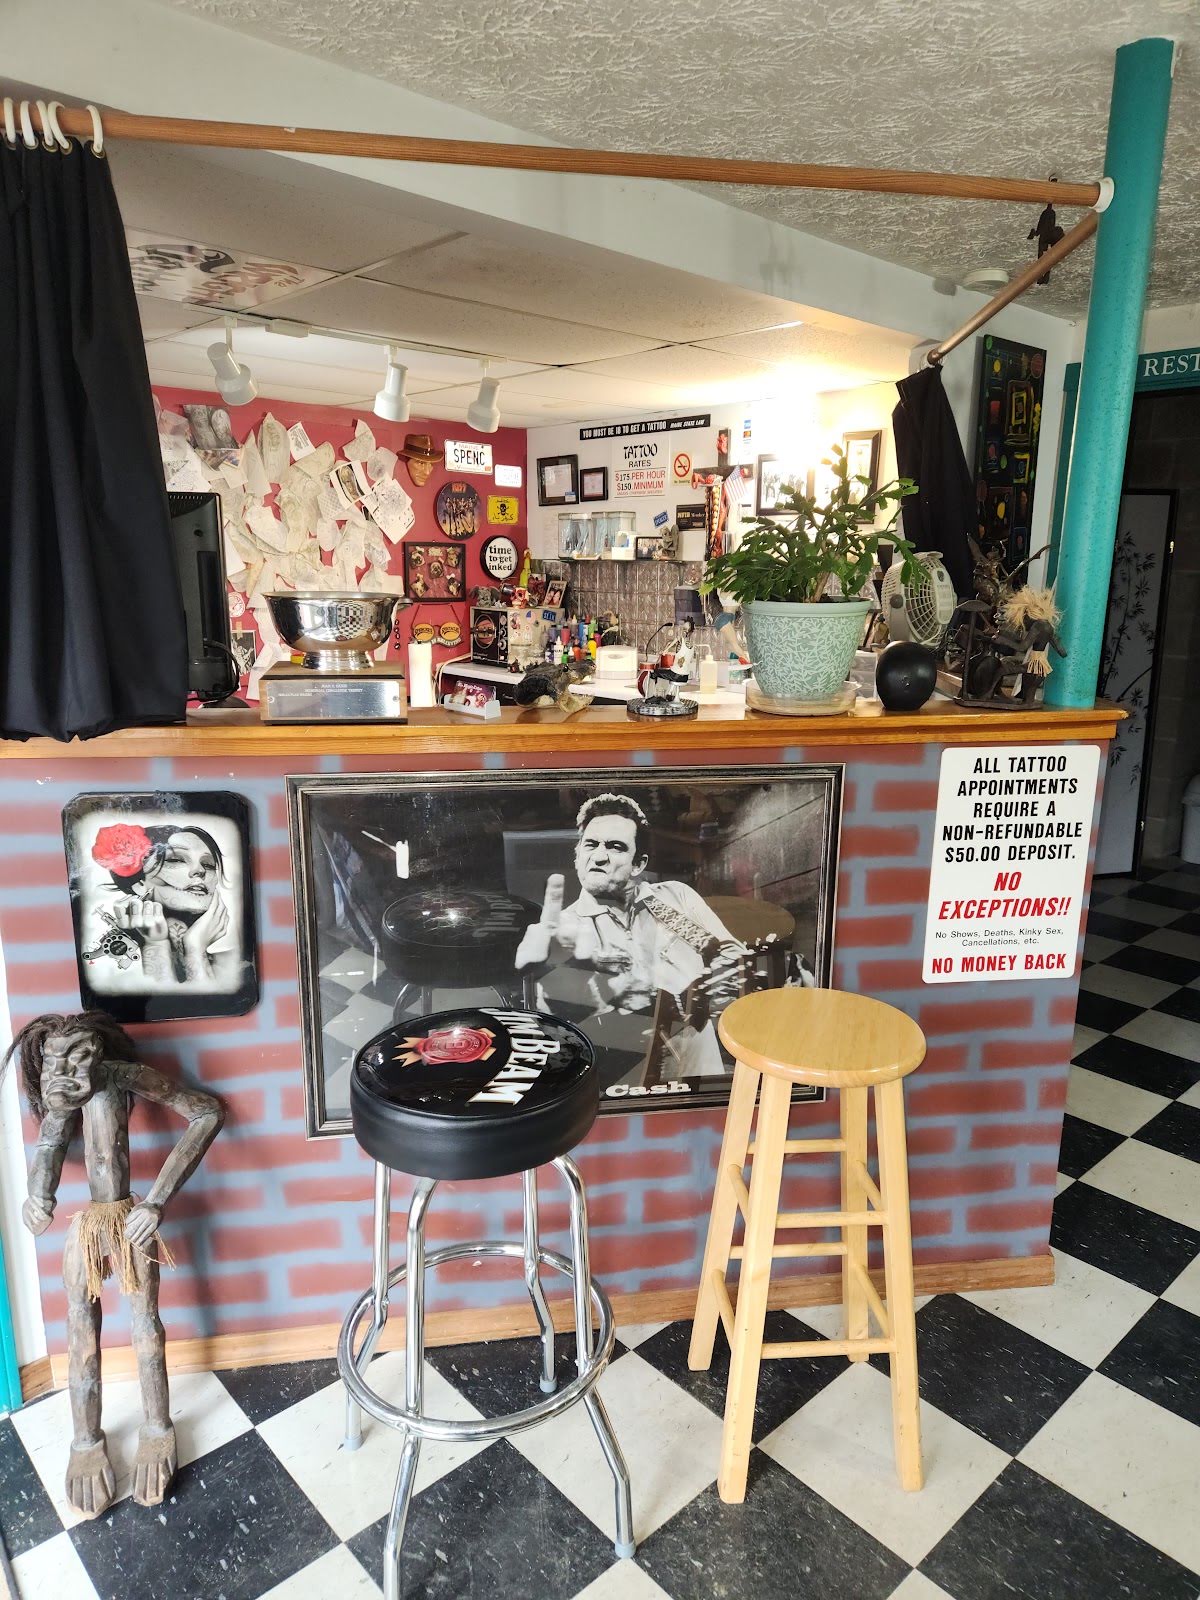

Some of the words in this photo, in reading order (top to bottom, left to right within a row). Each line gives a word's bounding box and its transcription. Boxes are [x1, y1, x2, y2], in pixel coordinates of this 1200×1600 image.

[583, 430, 592, 439] YOU
[593, 428, 607, 437] MUST
[622, 425, 630, 434] TO
[630, 424, 641, 433] GET
[641, 423, 646, 432] A
[646, 421, 667, 431] TATTOO
[453, 448, 485, 465] SPENC
[623, 443, 658, 459] TATTOO
[628, 459, 652, 468] RATES
[631, 472, 644, 480] PER
[646, 470, 665, 479] HOUR
[633, 480, 664, 490] MINIMUM
[489, 545, 512, 555] time
[488, 563, 512, 571] inked
[499, 556, 512, 564] get
[973, 757, 1000, 774] ALL
[1008, 755, 1067, 773] TATTOO
[957, 777, 1078, 797] APPOINTMENTS
[973, 801, 1039, 820] REQUIRE
[1046, 800, 1056, 817] A
[942, 822, 1083, 841] NON-REFUNDABLE
[945, 845, 1000, 863] $50.00
[1007, 844, 1076, 861] DEPOSIT.
[993, 871, 1022, 891] NO
[938, 897, 1072, 920] EXCEPTIONS!!
[935, 931, 947, 939] No
[950, 930, 981, 938] Shows,
[984, 928, 1016, 937] Deaths,
[1019, 928, 1042, 936] Kinky
[1045, 927, 1064, 936] Sex,
[962, 938, 1021, 947] Cancellations,
[1023, 937, 1040, 945] etc.
[932, 957, 953, 974] NO
[961, 955, 1017, 973] MONEY
[1024, 953, 1067, 970] BACK
[479, 1008, 546, 1037] JIM
[467, 1037, 561, 1106] BEAM
[605, 1080, 692, 1097] Cash
